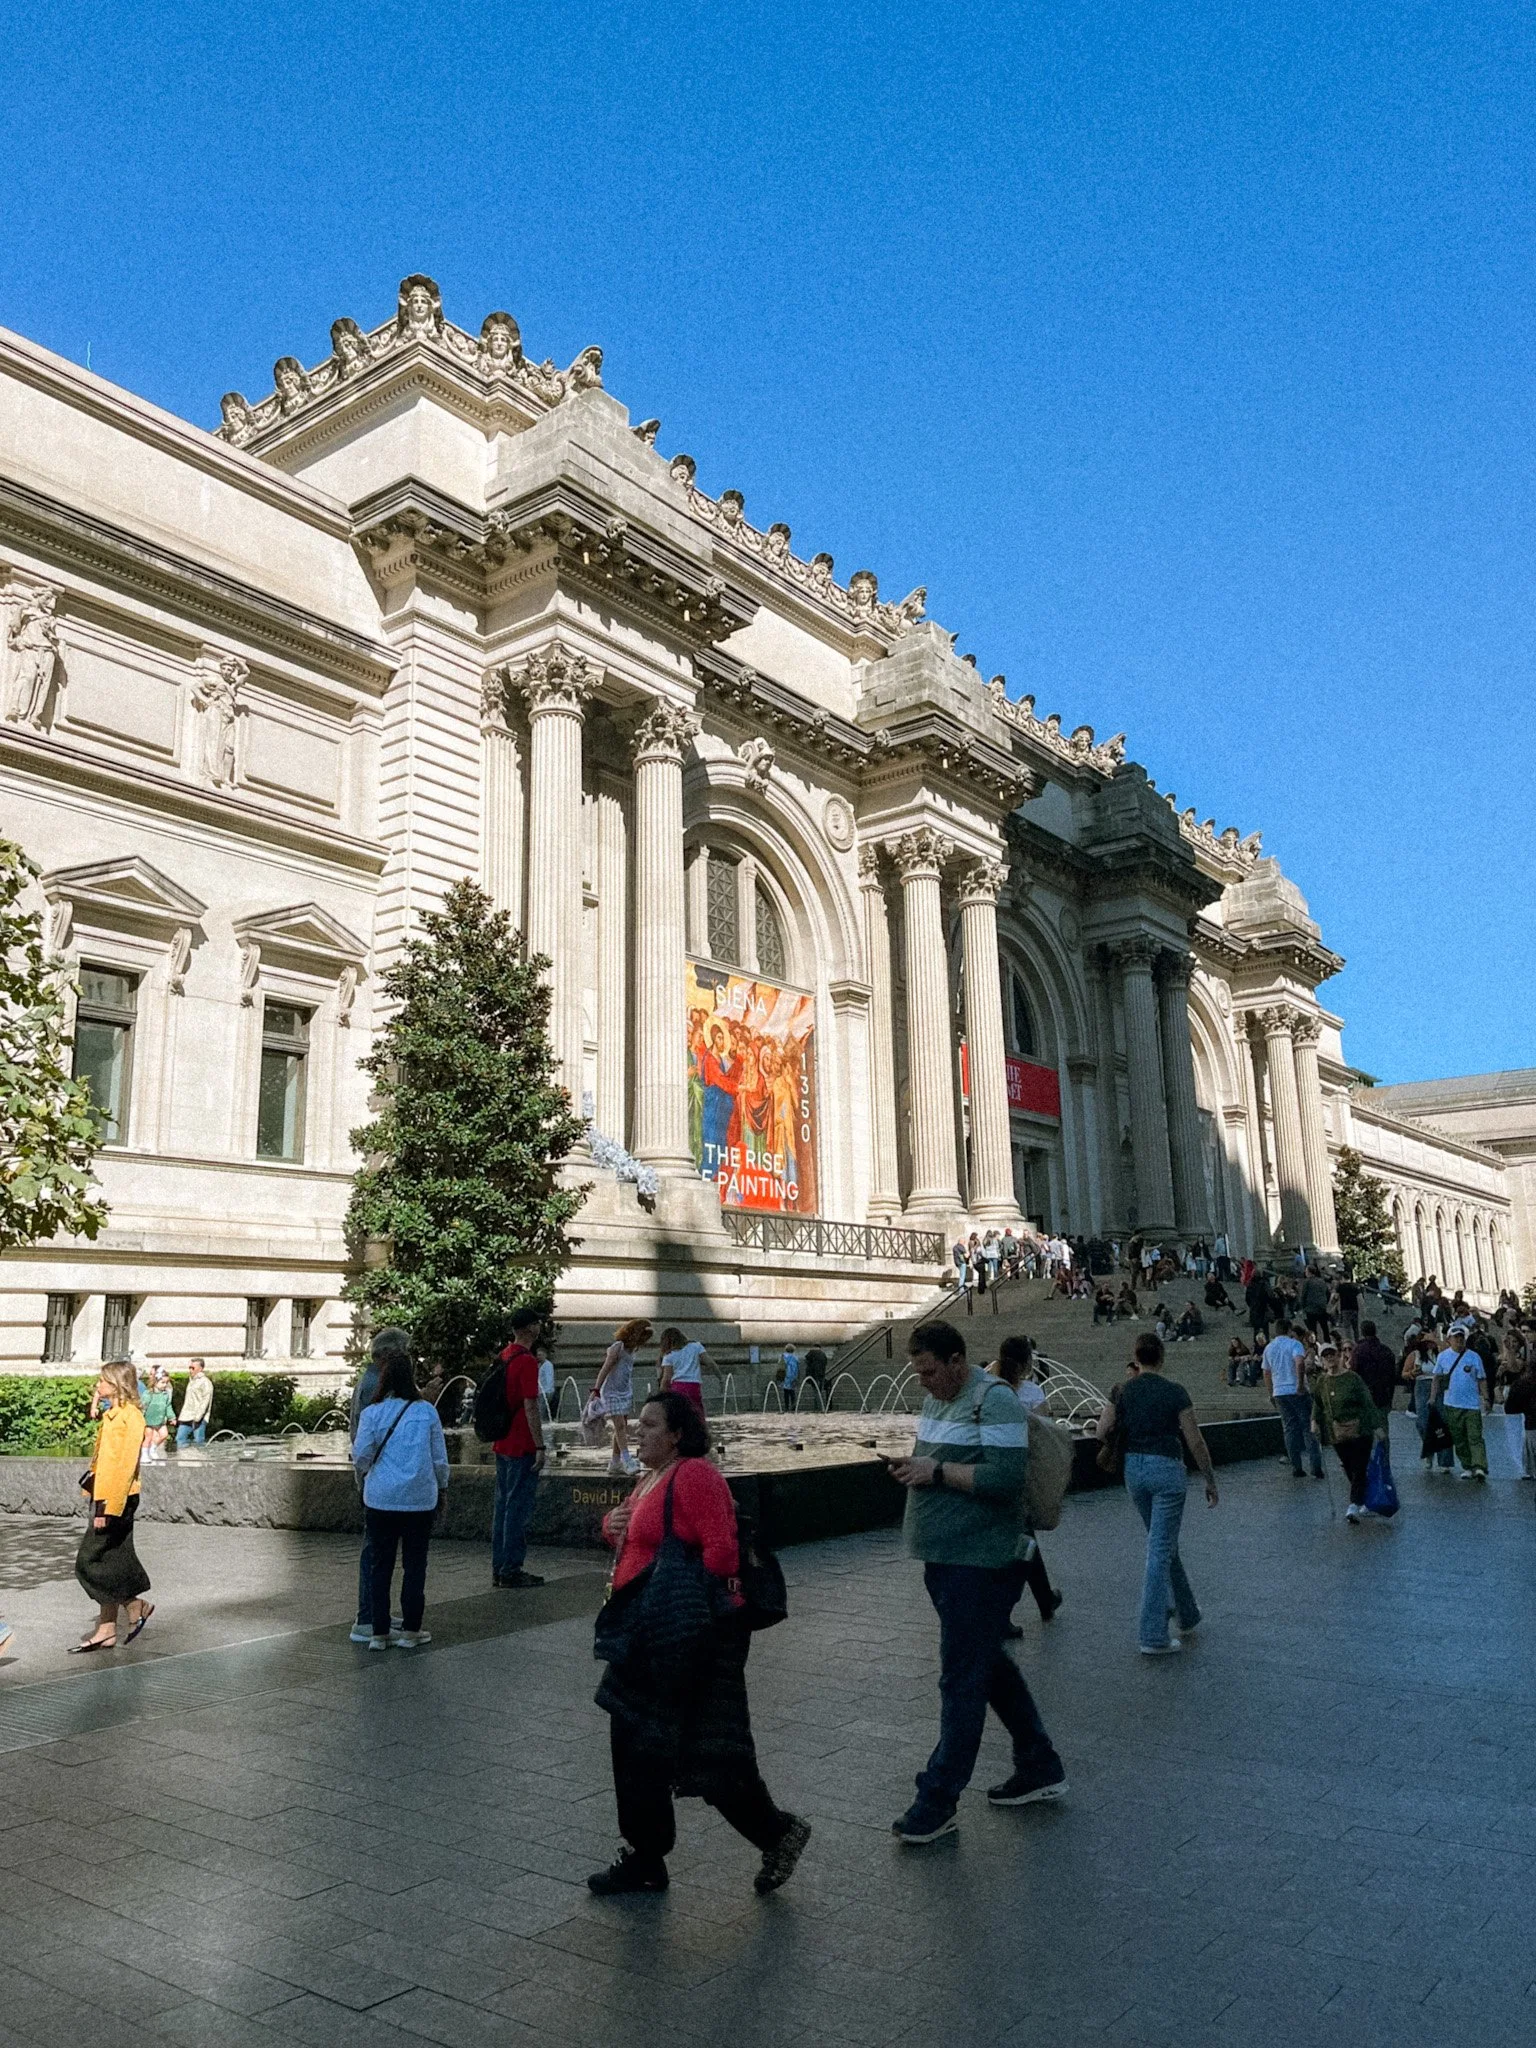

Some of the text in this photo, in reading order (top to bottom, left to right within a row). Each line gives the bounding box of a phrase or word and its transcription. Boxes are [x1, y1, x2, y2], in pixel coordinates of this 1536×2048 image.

[716, 984, 768, 1016] SIENA
[800, 1054, 811, 1142] 1350
[704, 1143, 784, 1174] THE RISE
[717, 1171, 799, 1201] PAINTING
[572, 1488, 607, 1504] David
